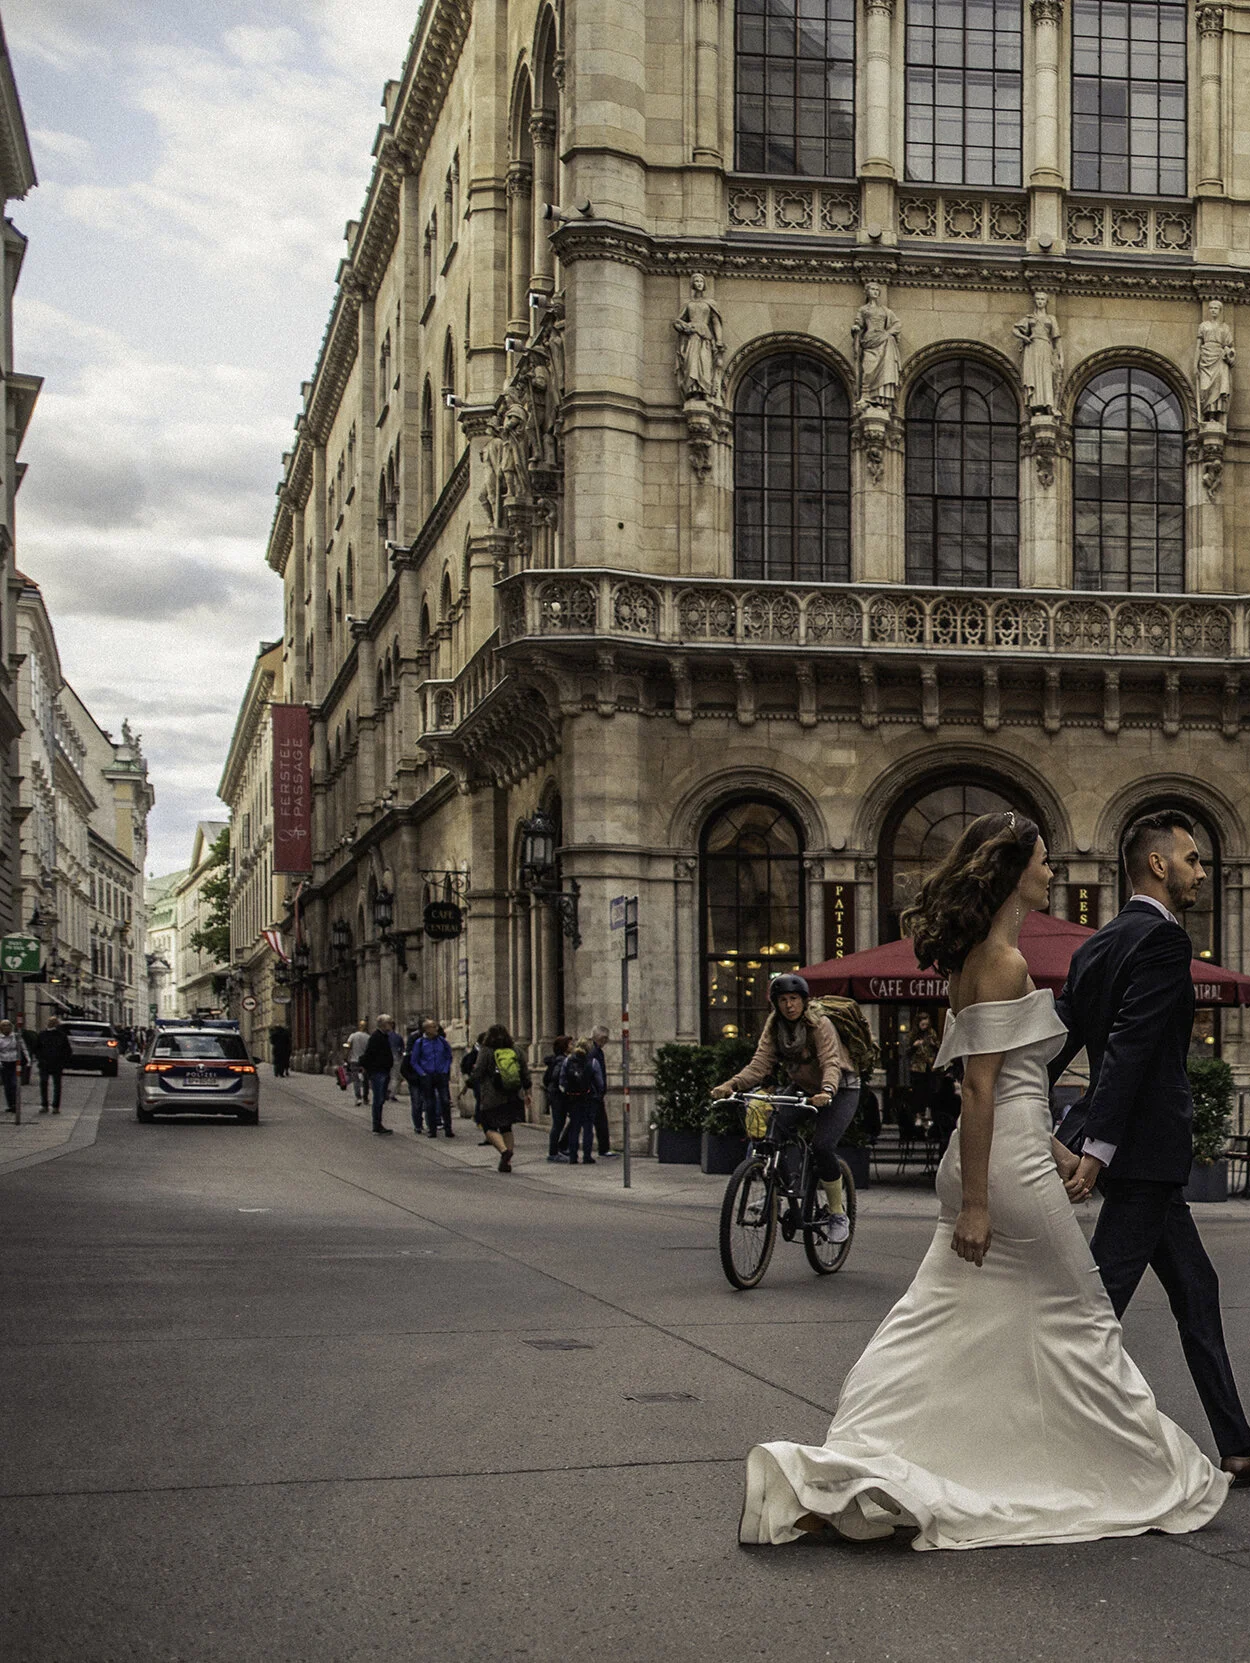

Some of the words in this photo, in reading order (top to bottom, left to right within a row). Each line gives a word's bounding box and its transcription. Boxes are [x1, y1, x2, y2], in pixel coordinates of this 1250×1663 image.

[280, 738, 291, 816] FERSTEL
[292, 738, 304, 817] PASSAGE
[1079, 888, 1088, 924] RES
